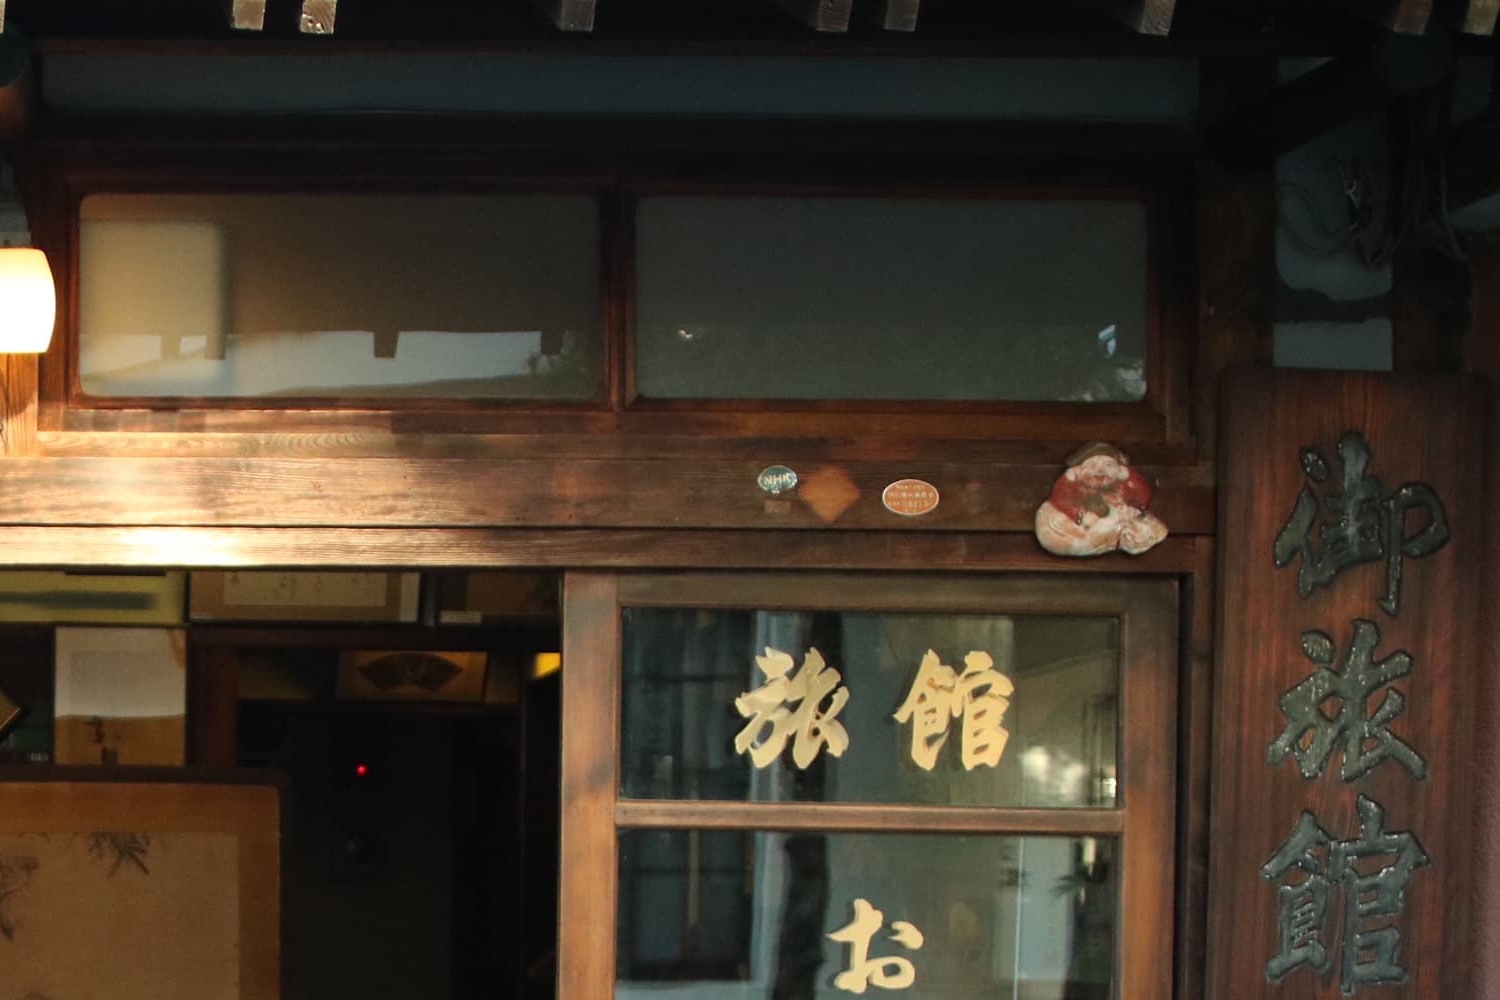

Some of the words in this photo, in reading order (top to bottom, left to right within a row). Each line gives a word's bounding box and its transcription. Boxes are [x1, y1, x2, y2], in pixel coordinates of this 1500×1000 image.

[764, 473, 790, 485] NHK
[734, 646, 1014, 771] 旅館
[1261, 430, 1451, 996] 御旅館
